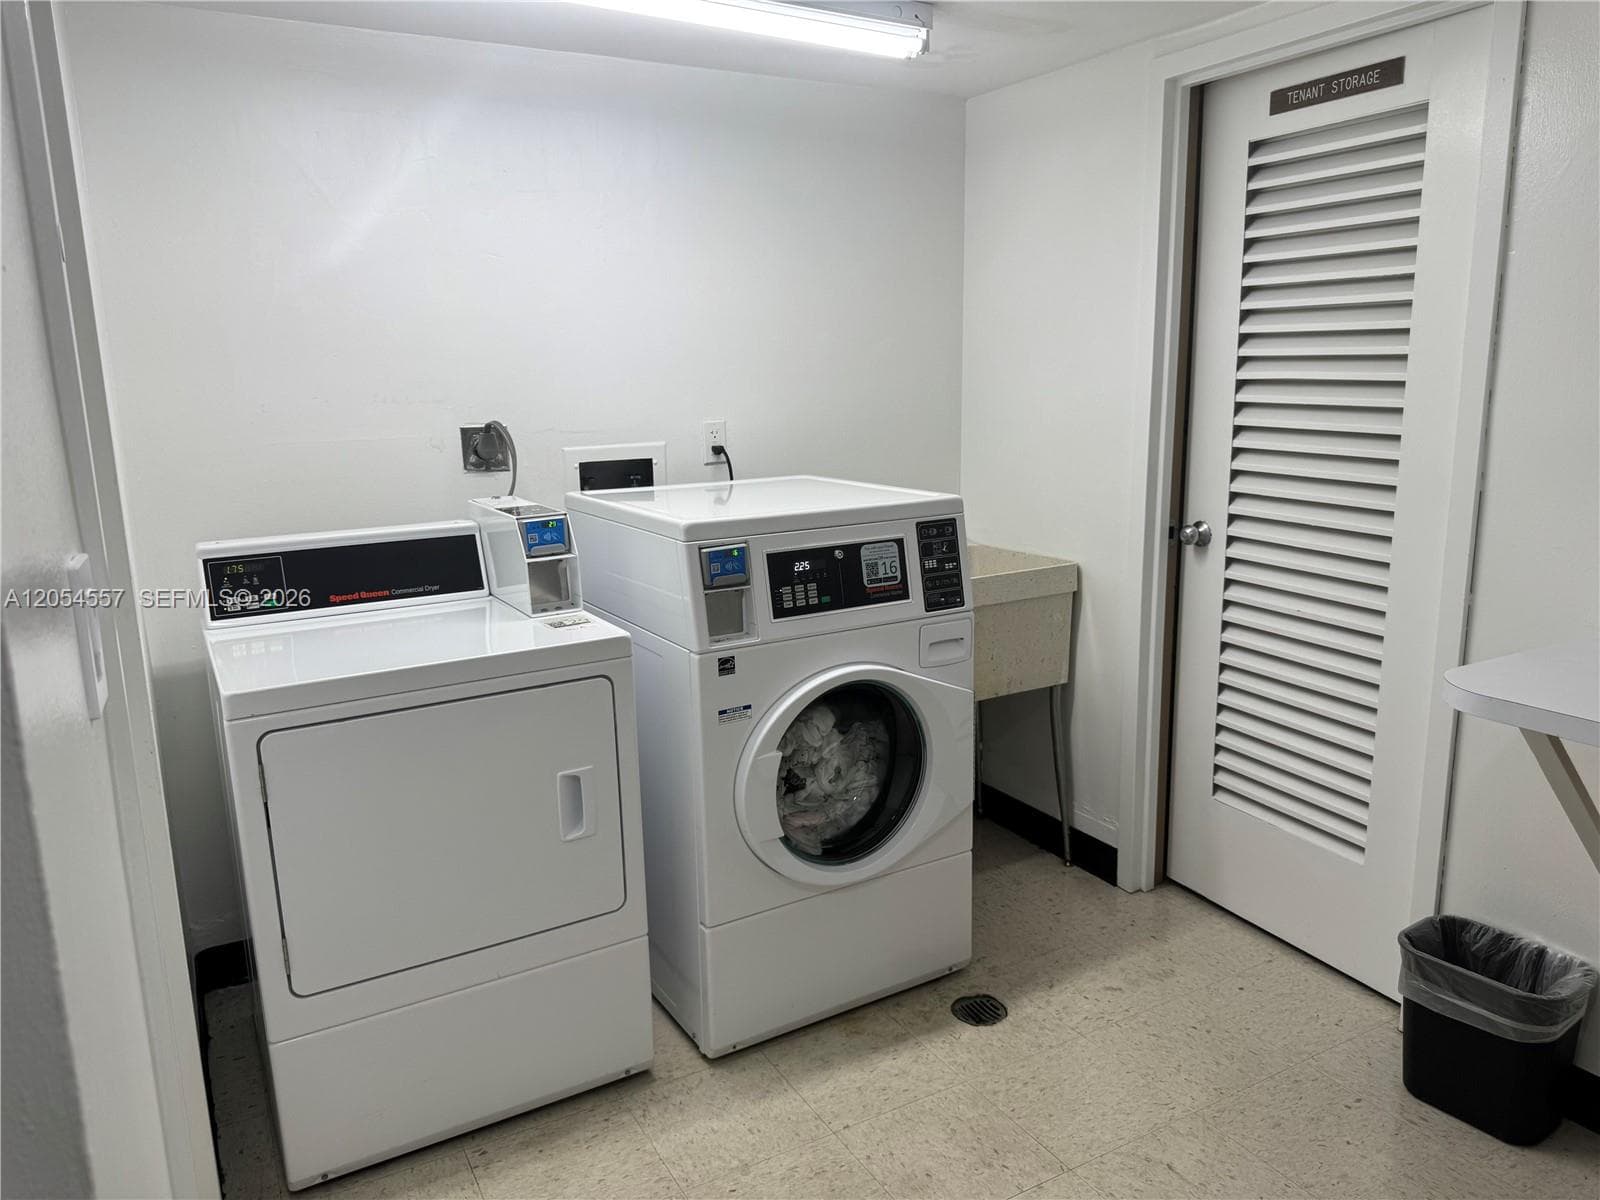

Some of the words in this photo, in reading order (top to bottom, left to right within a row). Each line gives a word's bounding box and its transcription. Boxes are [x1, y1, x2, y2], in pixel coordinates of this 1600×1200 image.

[1287, 84, 1325, 104] TENANT
[1331, 69, 1381, 94] STORAGE
[881, 560, 898, 576] 16
[329, 592, 360, 602] Speed
[360, 590, 389, 599] Queen
